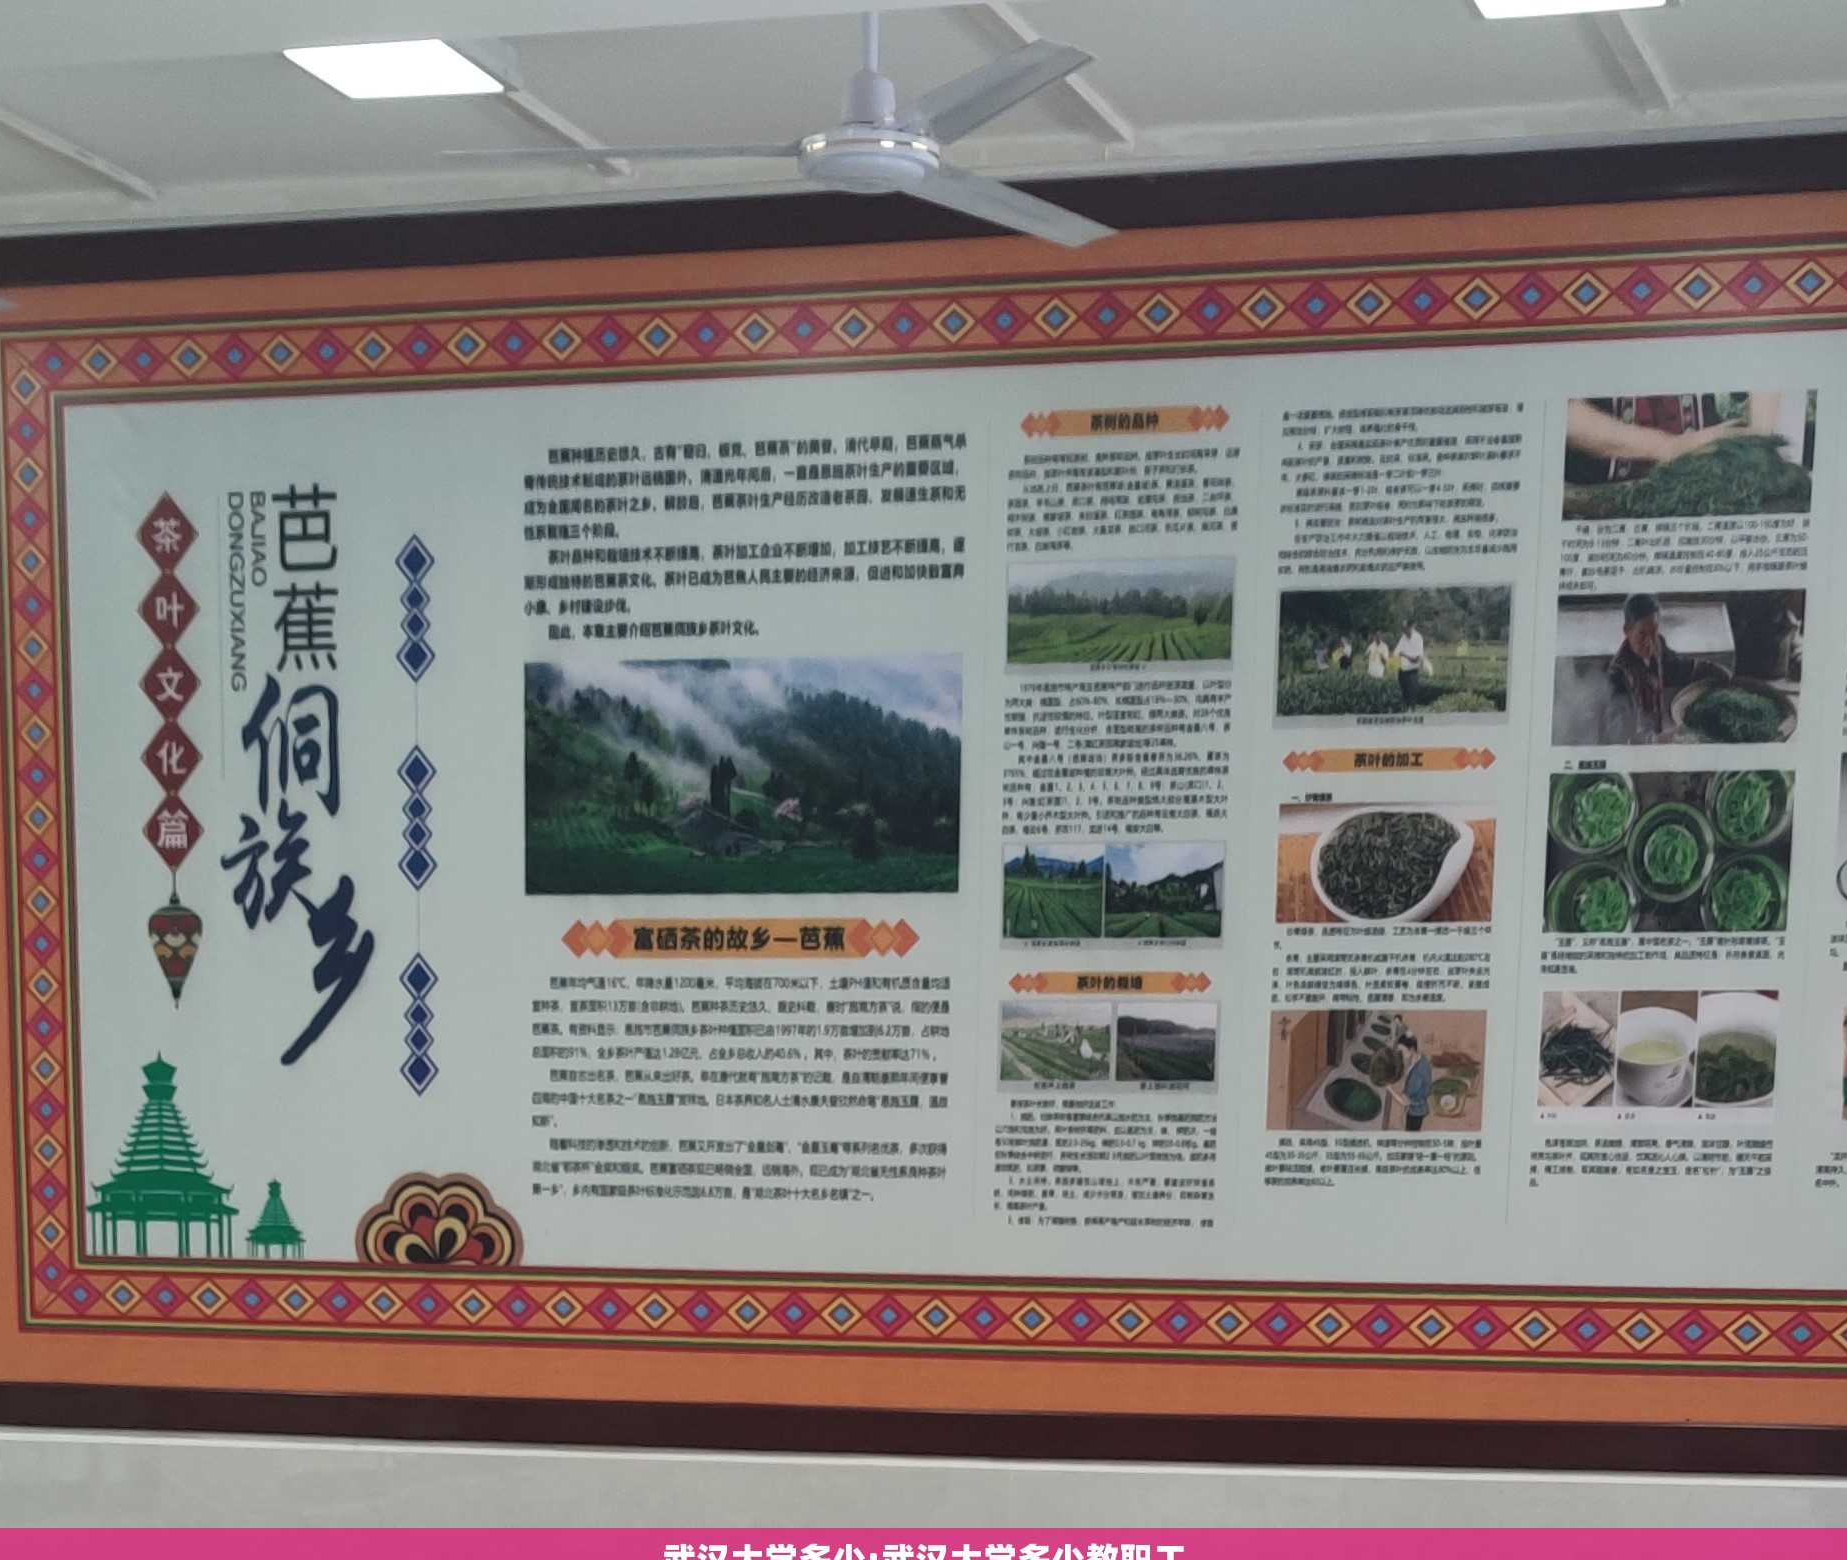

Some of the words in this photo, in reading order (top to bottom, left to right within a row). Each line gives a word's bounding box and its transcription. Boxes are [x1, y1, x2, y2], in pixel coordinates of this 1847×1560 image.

[250, 491, 268, 588] BAJIAO
[227, 491, 247, 692] DONGZUXIANG
[152, 517, 189, 849] 茶叶文化篇
[221, 483, 374, 1065] 芭蕉侗族乡
[1353, 751, 1423, 769] 茶叶的加工
[634, 926, 846, 952] 富硒茶的故乡—芭蕉
[1075, 974, 1143, 992] 茶叶的栽培
